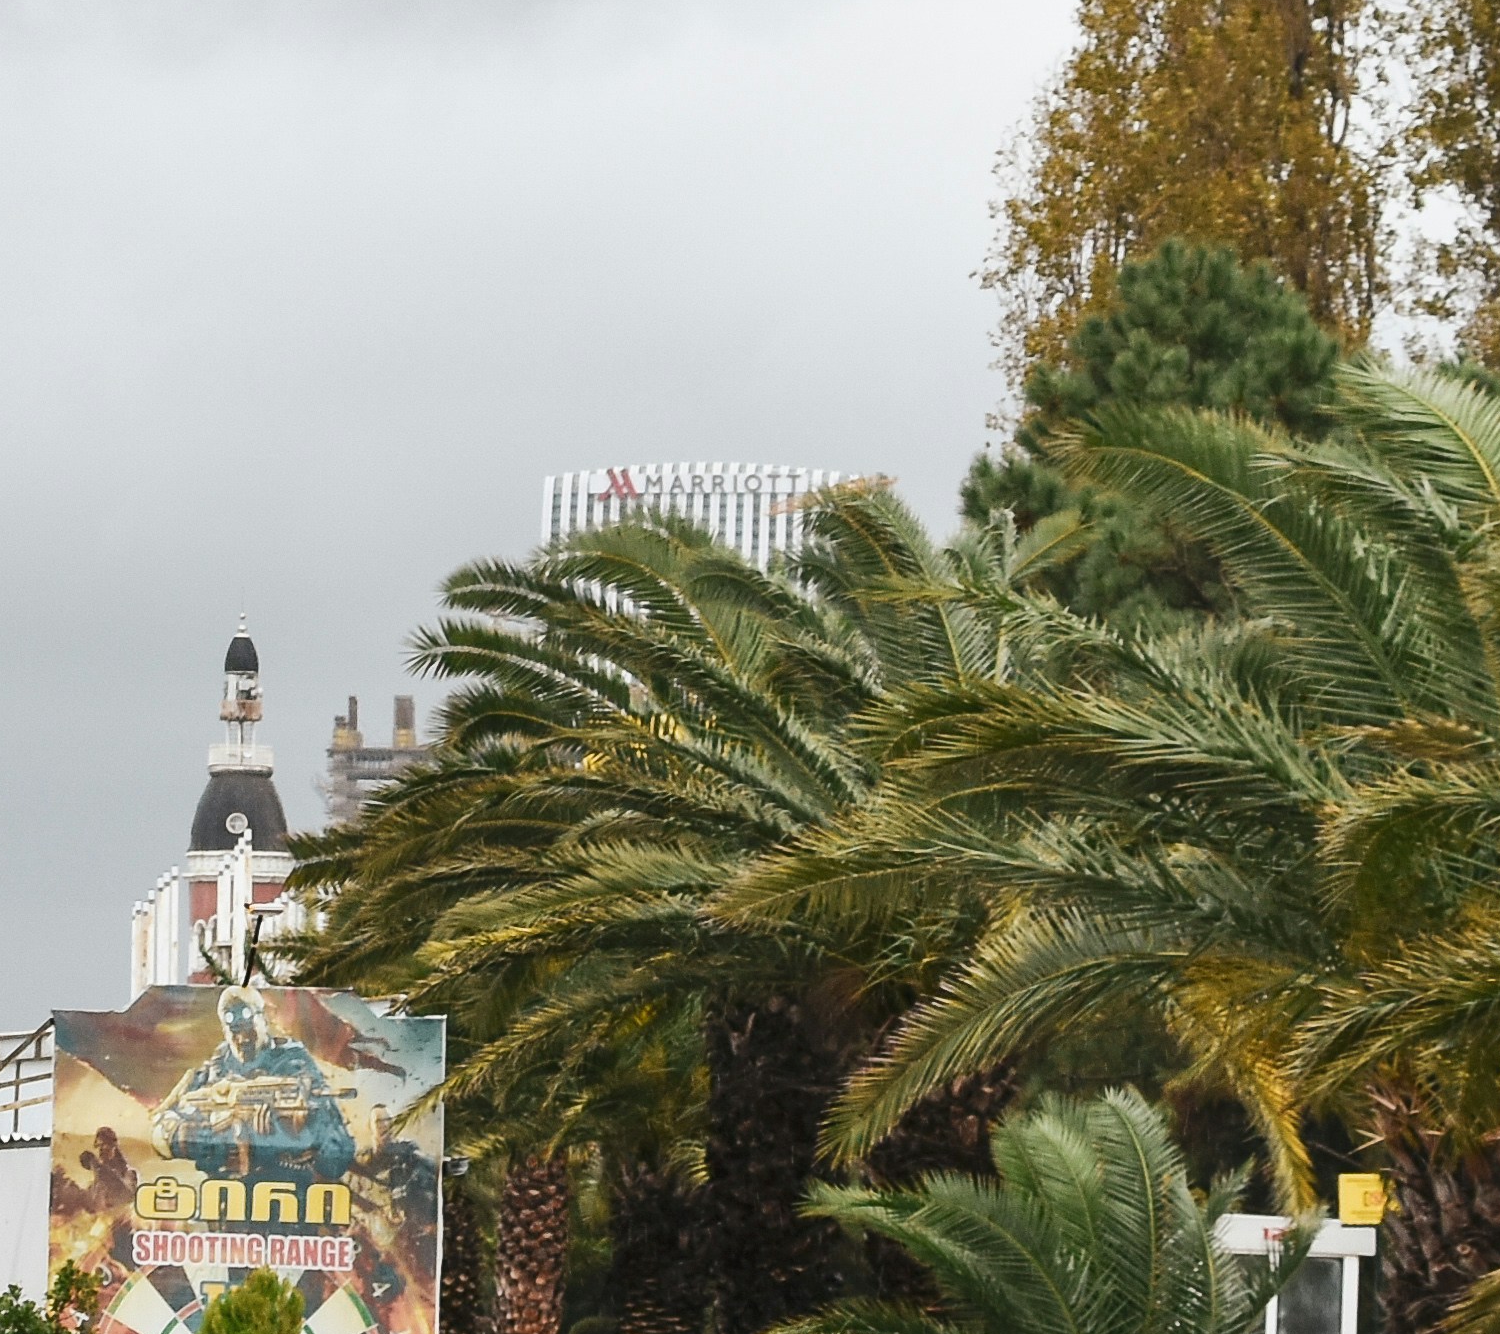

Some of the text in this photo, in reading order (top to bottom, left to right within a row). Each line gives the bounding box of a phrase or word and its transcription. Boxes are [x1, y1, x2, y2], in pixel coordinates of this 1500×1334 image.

[645, 474, 801, 494] MARRIOTT
[135, 1177, 350, 1225] ტირი
[134, 1232, 268, 1267] SHOOTING
[270, 1237, 352, 1269] RANGE
[372, 1281, 391, 1298] 4
